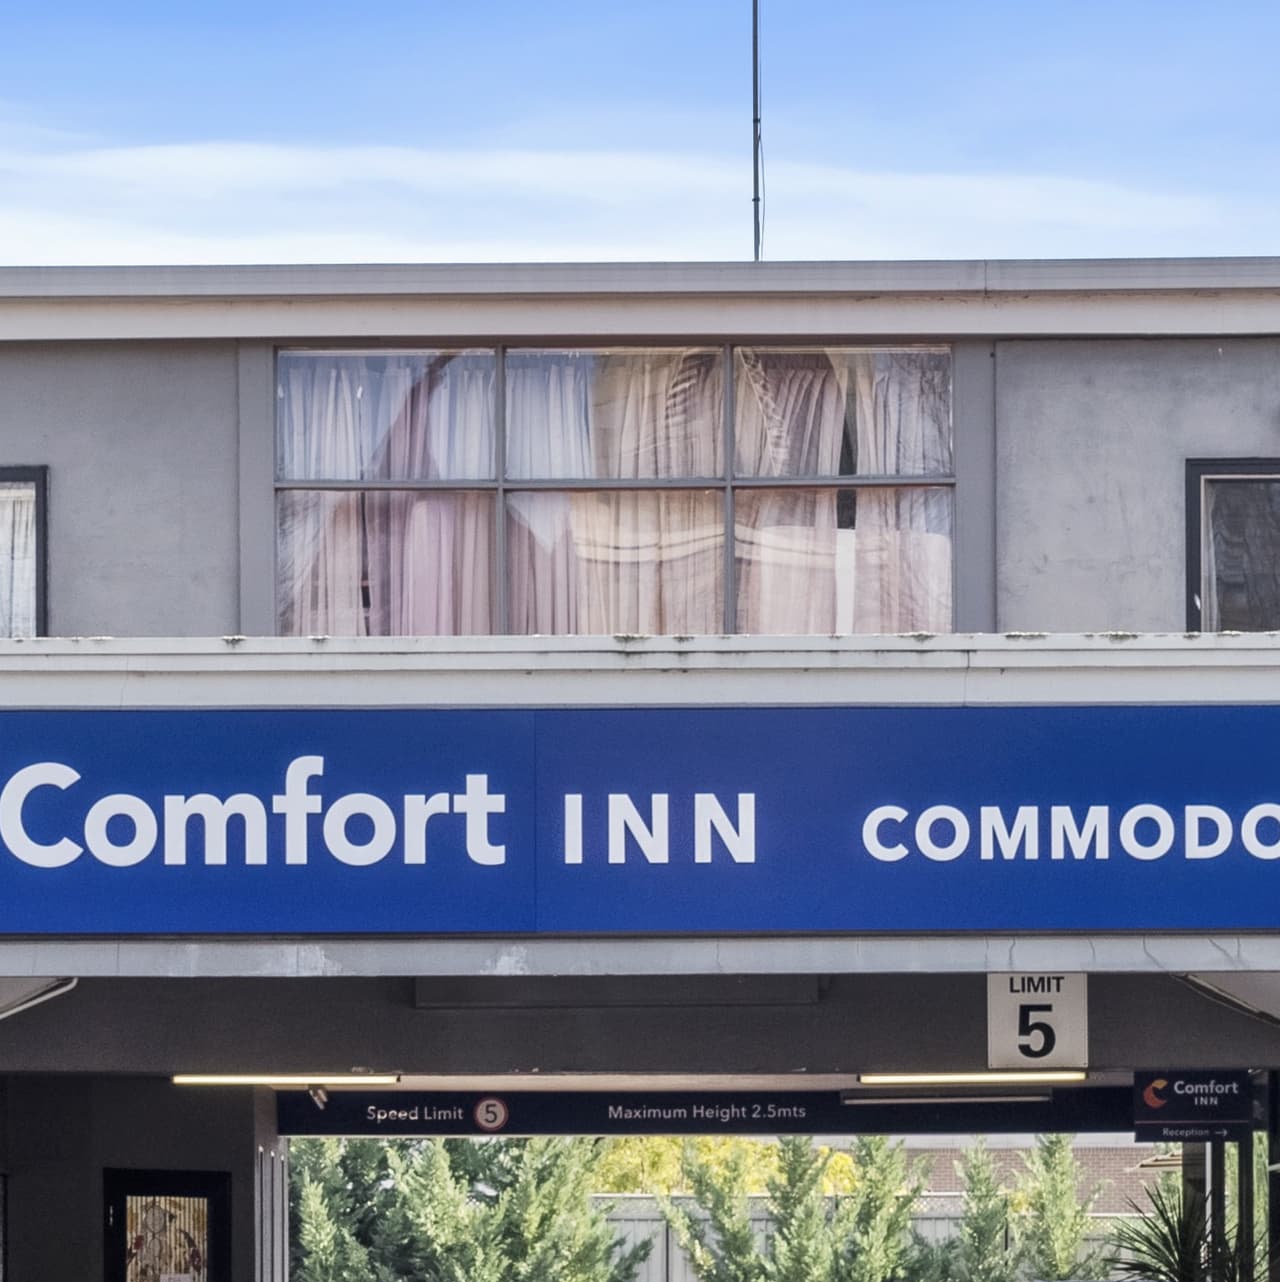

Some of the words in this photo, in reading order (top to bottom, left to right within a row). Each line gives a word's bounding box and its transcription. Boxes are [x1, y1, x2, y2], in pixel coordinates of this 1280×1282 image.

[563, 792, 756, 865] INN
[1008, 975, 1065, 994] LIMIT
[1017, 1003, 1057, 1059] 5
[1173, 1080, 1239, 1095] Comfort
[1194, 1097, 1219, 1106] INN
[366, 1105, 419, 1121] Speed
[424, 1105, 464, 1120] Limit
[482, 1103, 498, 1123] 5
[607, 1104, 688, 1120] Maximum
[692, 1103, 746, 1122] Height
[751, 1103, 807, 1119] 2.5mts
[1162, 1127, 1210, 1138] Reception
